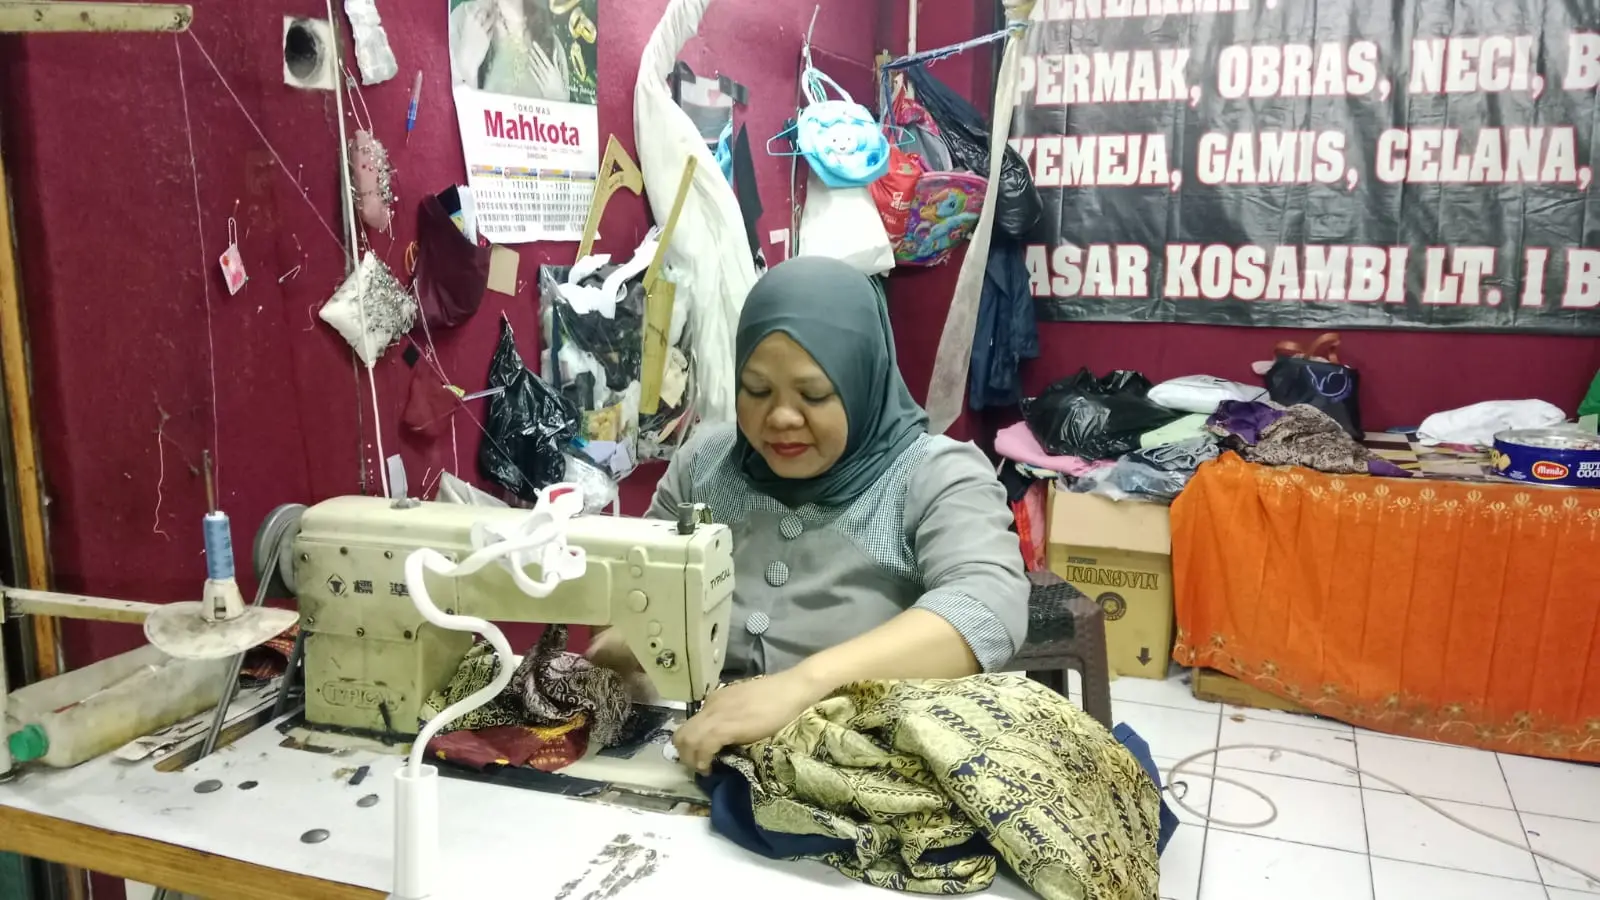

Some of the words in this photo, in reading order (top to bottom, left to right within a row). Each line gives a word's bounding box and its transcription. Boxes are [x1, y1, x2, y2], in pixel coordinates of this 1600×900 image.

[1014, 48, 1202, 105] PERMAK,
[1218, 41, 1391, 102] OBRAS,
[1409, 34, 1544, 101] NECI,
[483, 109, 580, 146] Mahkota
[513, 103, 534, 112] TOKO
[1196, 130, 1359, 191] GAMIS,
[1375, 126, 1592, 191] CELANA,
[1163, 243, 1408, 303] KOSAMBI
[1422, 246, 1502, 306] LT.
[1066, 565, 1159, 590] MAGNUM
